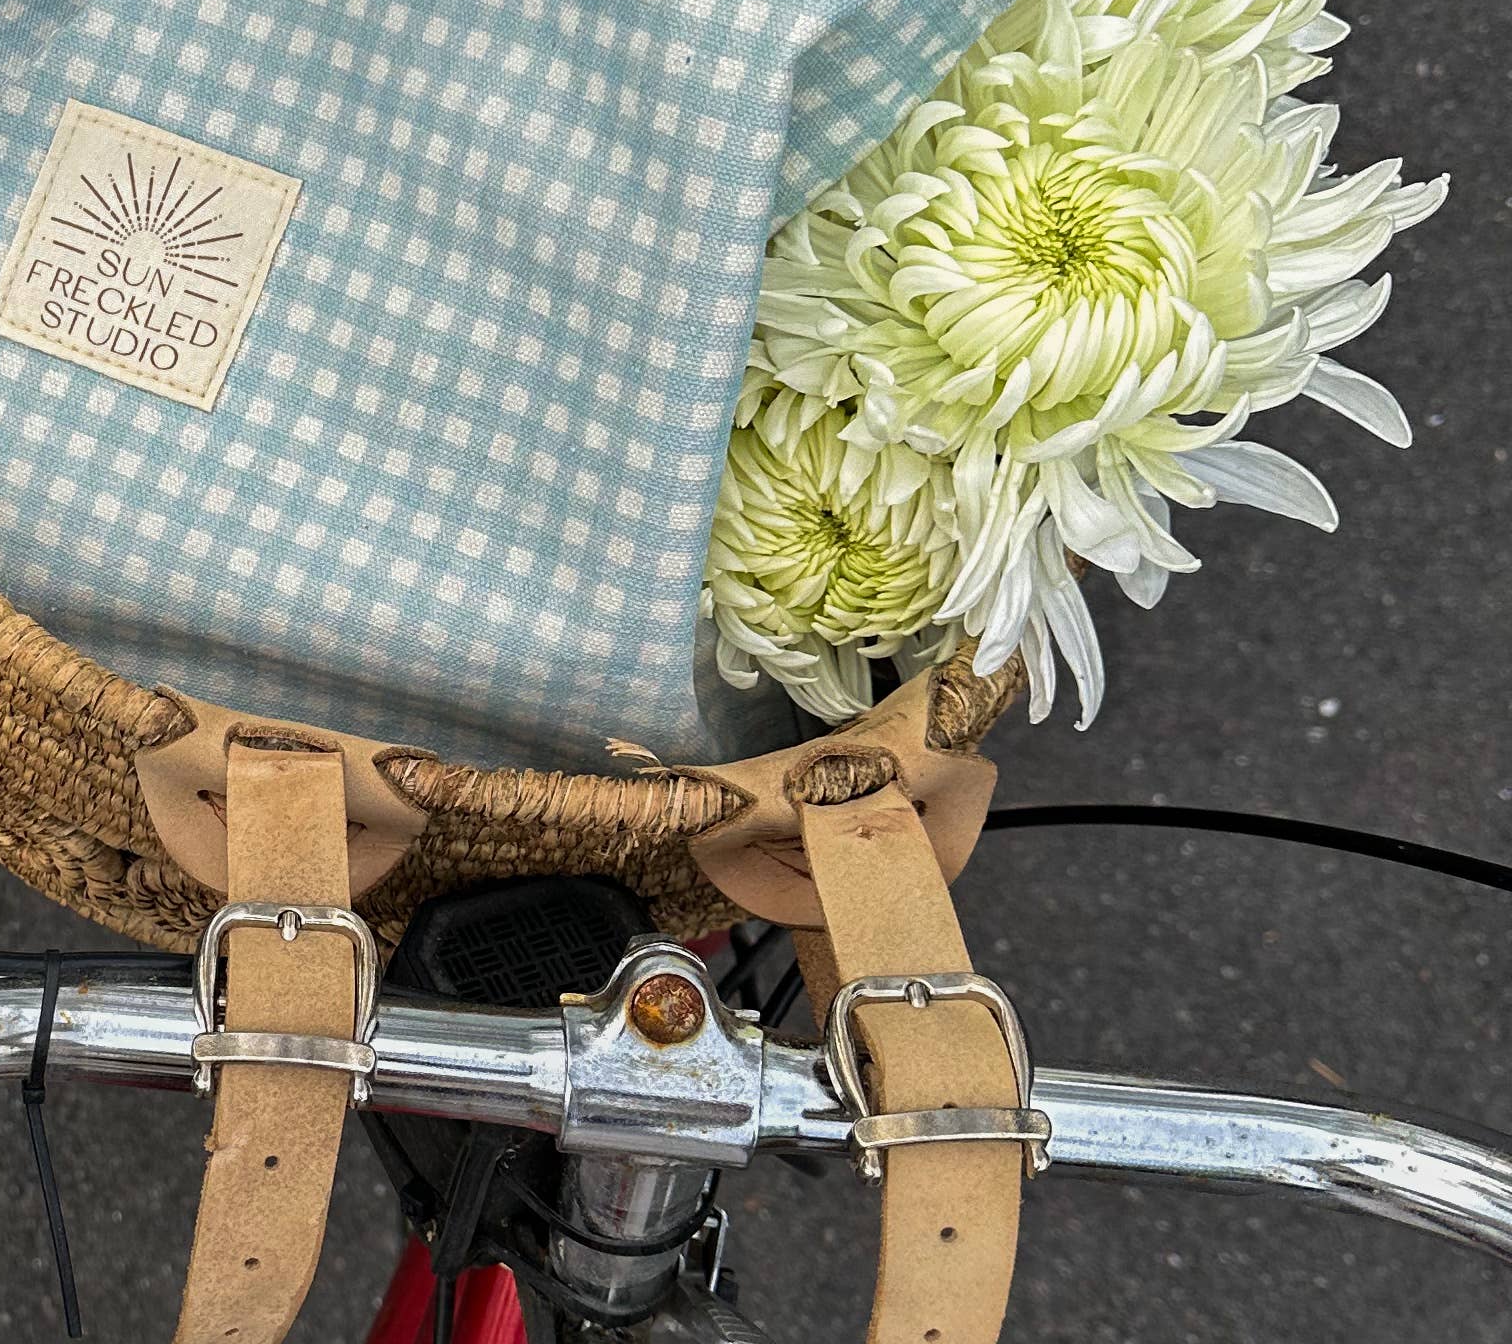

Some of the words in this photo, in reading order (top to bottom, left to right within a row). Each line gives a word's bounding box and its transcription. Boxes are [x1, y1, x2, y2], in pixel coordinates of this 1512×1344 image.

[26, 259, 218, 348] FRECKLED
[97, 249, 174, 297] SUN
[40, 300, 179, 370] STUDIO
